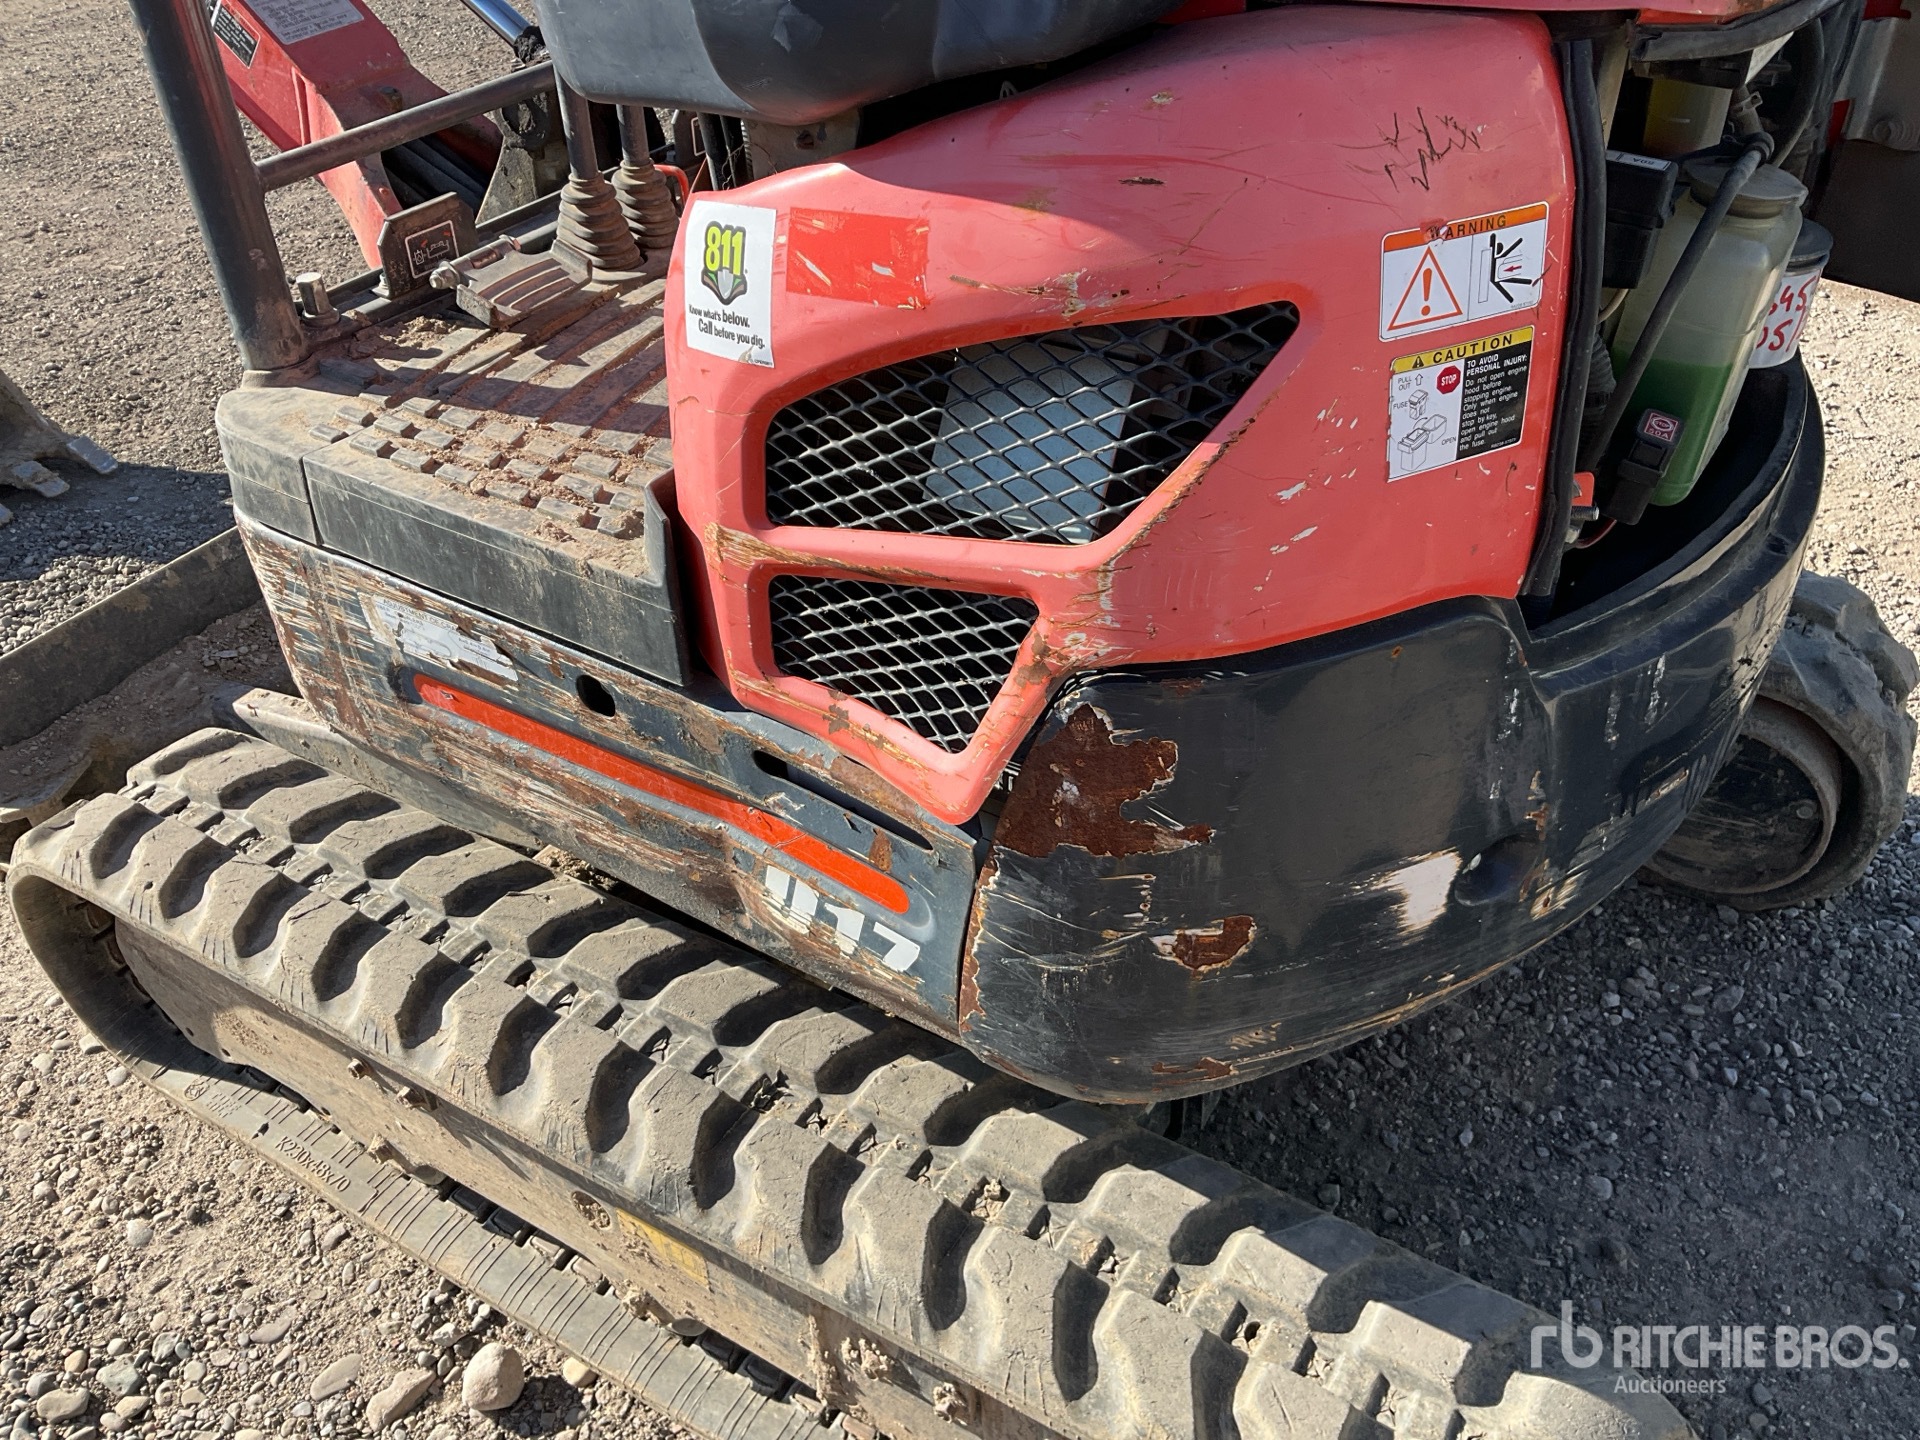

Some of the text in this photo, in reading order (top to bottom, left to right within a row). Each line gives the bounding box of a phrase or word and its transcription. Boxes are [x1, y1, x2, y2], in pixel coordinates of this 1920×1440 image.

[1428, 215, 1507, 239] WARNING
[705, 225, 744, 276] 811
[689, 304, 750, 328] Know what's below.
[698, 318, 765, 350] Call before you dig.
[1432, 334, 1512, 363] CAUTION
[1466, 354, 1527, 376] PERSONAL INJURY:
[1467, 353, 1498, 368] TO AVOID
[1398, 376, 1412, 384] PULL
[1441, 374, 1457, 386] STOP
[1477, 376, 1488, 384] not
[1490, 371, 1505, 381] open
[1507, 365, 1527, 376] engine
[1398, 382, 1410, 391] OUT
[1464, 380, 1502, 395] hood before
[1393, 401, 1408, 409] FUSE
[1463, 391, 1518, 412] Only when engine
[1464, 391, 1490, 404] stopping
[1462, 407, 1490, 420] does not
[1461, 419, 1475, 428] stop
[1477, 416, 1485, 424] by
[1461, 414, 1516, 436] open engine hood
[1441, 436, 1457, 445] OPEN
[1460, 427, 1498, 444] and pull out
[1459, 443, 1469, 451] the
[275, 1136, 352, 1193] K230x48x70
